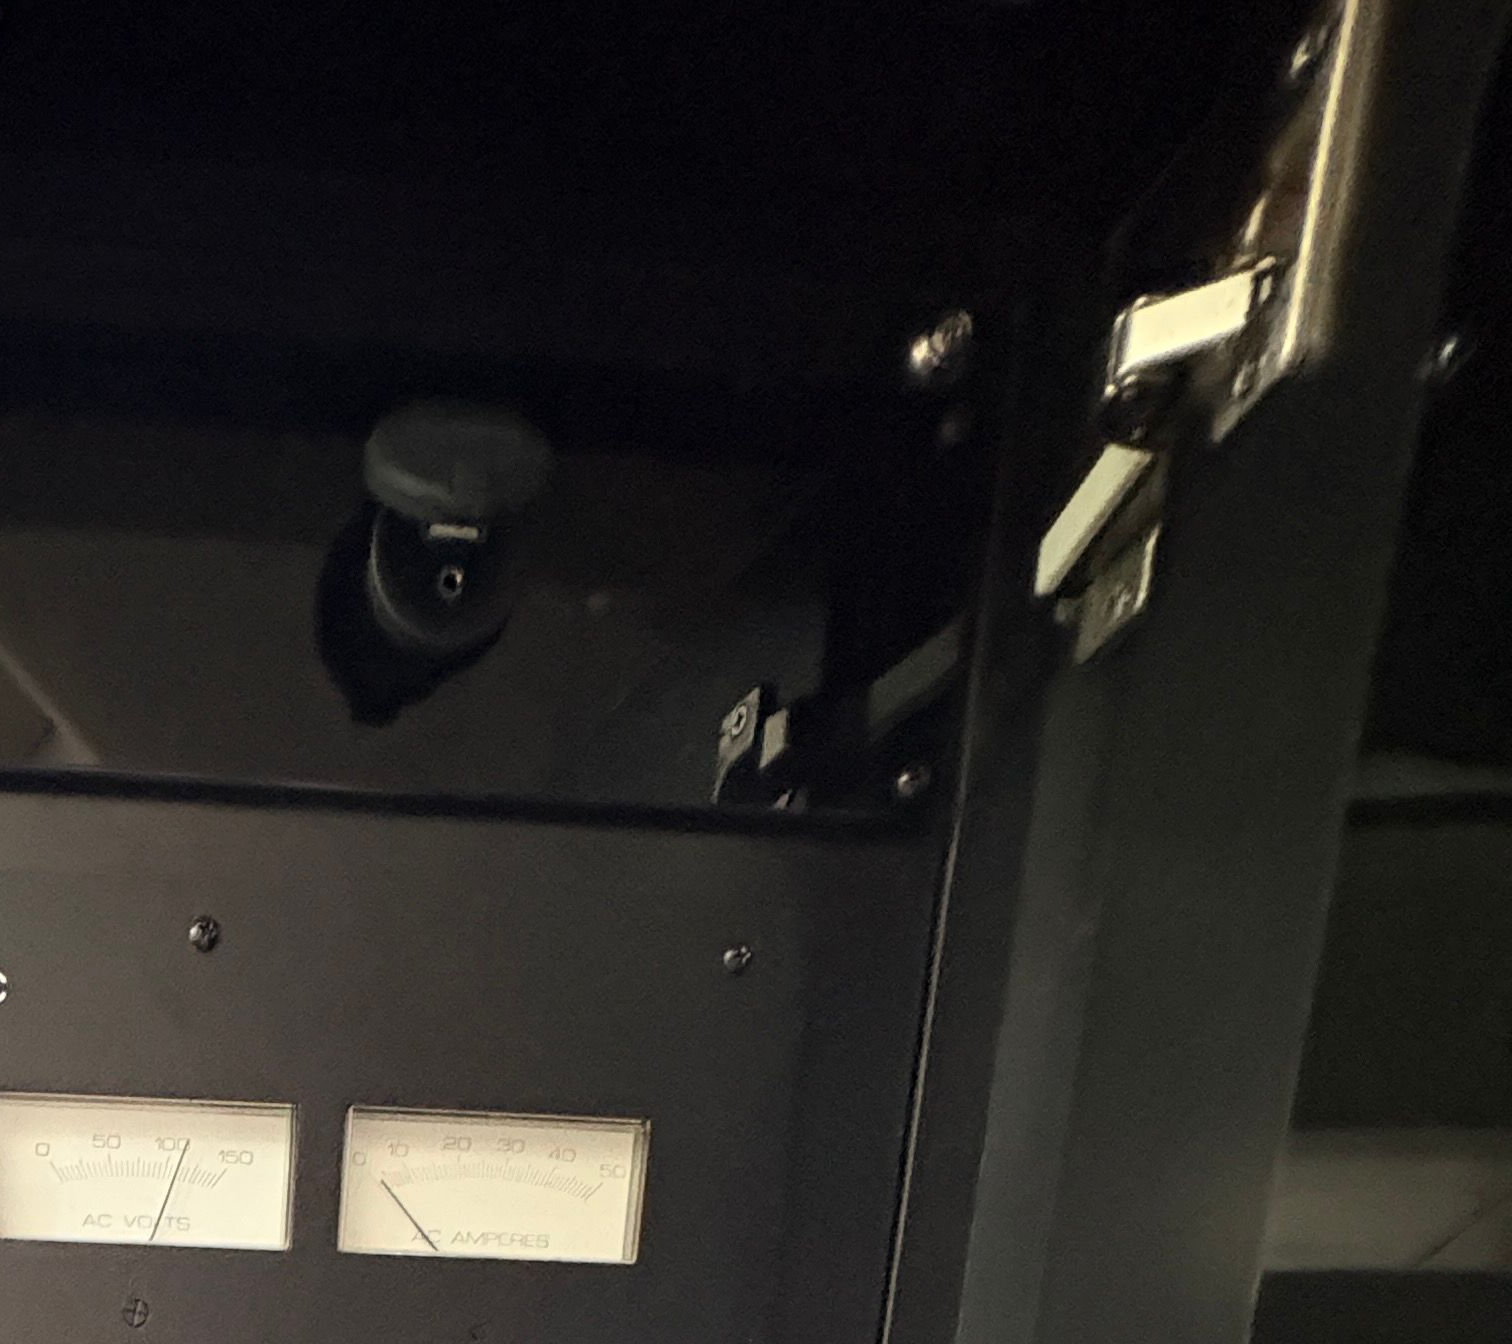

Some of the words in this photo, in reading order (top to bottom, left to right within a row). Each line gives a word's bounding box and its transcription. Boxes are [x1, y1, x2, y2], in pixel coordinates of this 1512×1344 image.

[93, 1134, 122, 1149] 50
[155, 1137, 191, 1151] 100
[218, 1150, 253, 1165] 150
